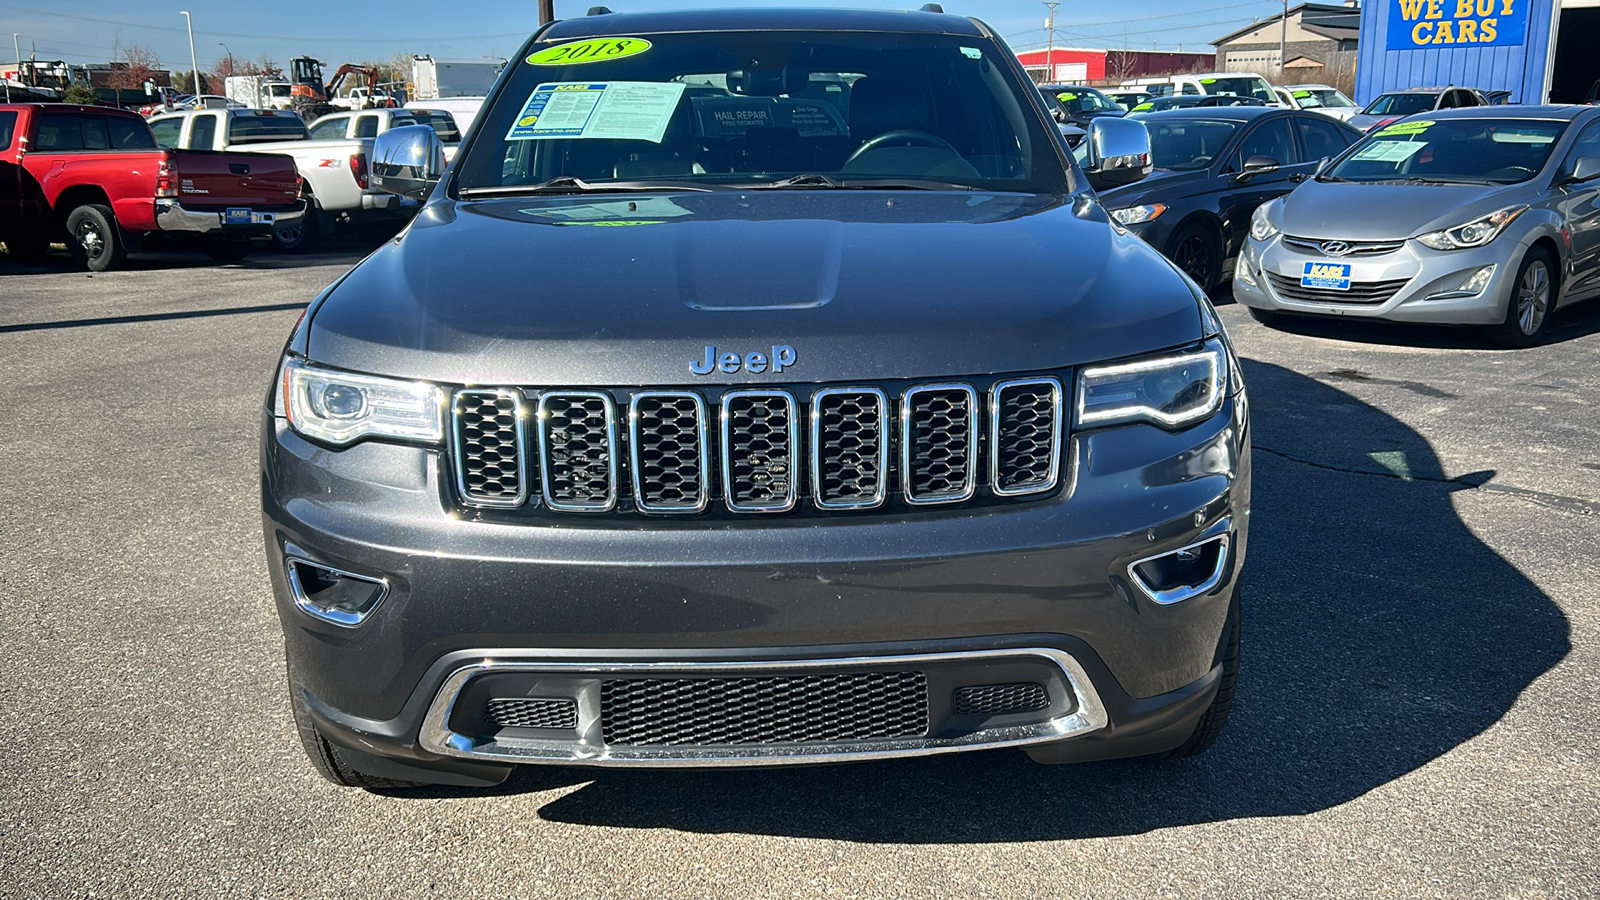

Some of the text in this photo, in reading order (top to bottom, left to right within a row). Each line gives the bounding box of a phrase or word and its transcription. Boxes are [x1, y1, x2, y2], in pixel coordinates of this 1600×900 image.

[1398, 0, 1514, 21] WE BUY
[1411, 18, 1498, 45] CARS
[546, 40, 632, 62] 2018
[714, 110, 768, 120] HAIL REPAIR
[1310, 265, 1344, 277] KARS
[689, 344, 798, 376] Jeep
